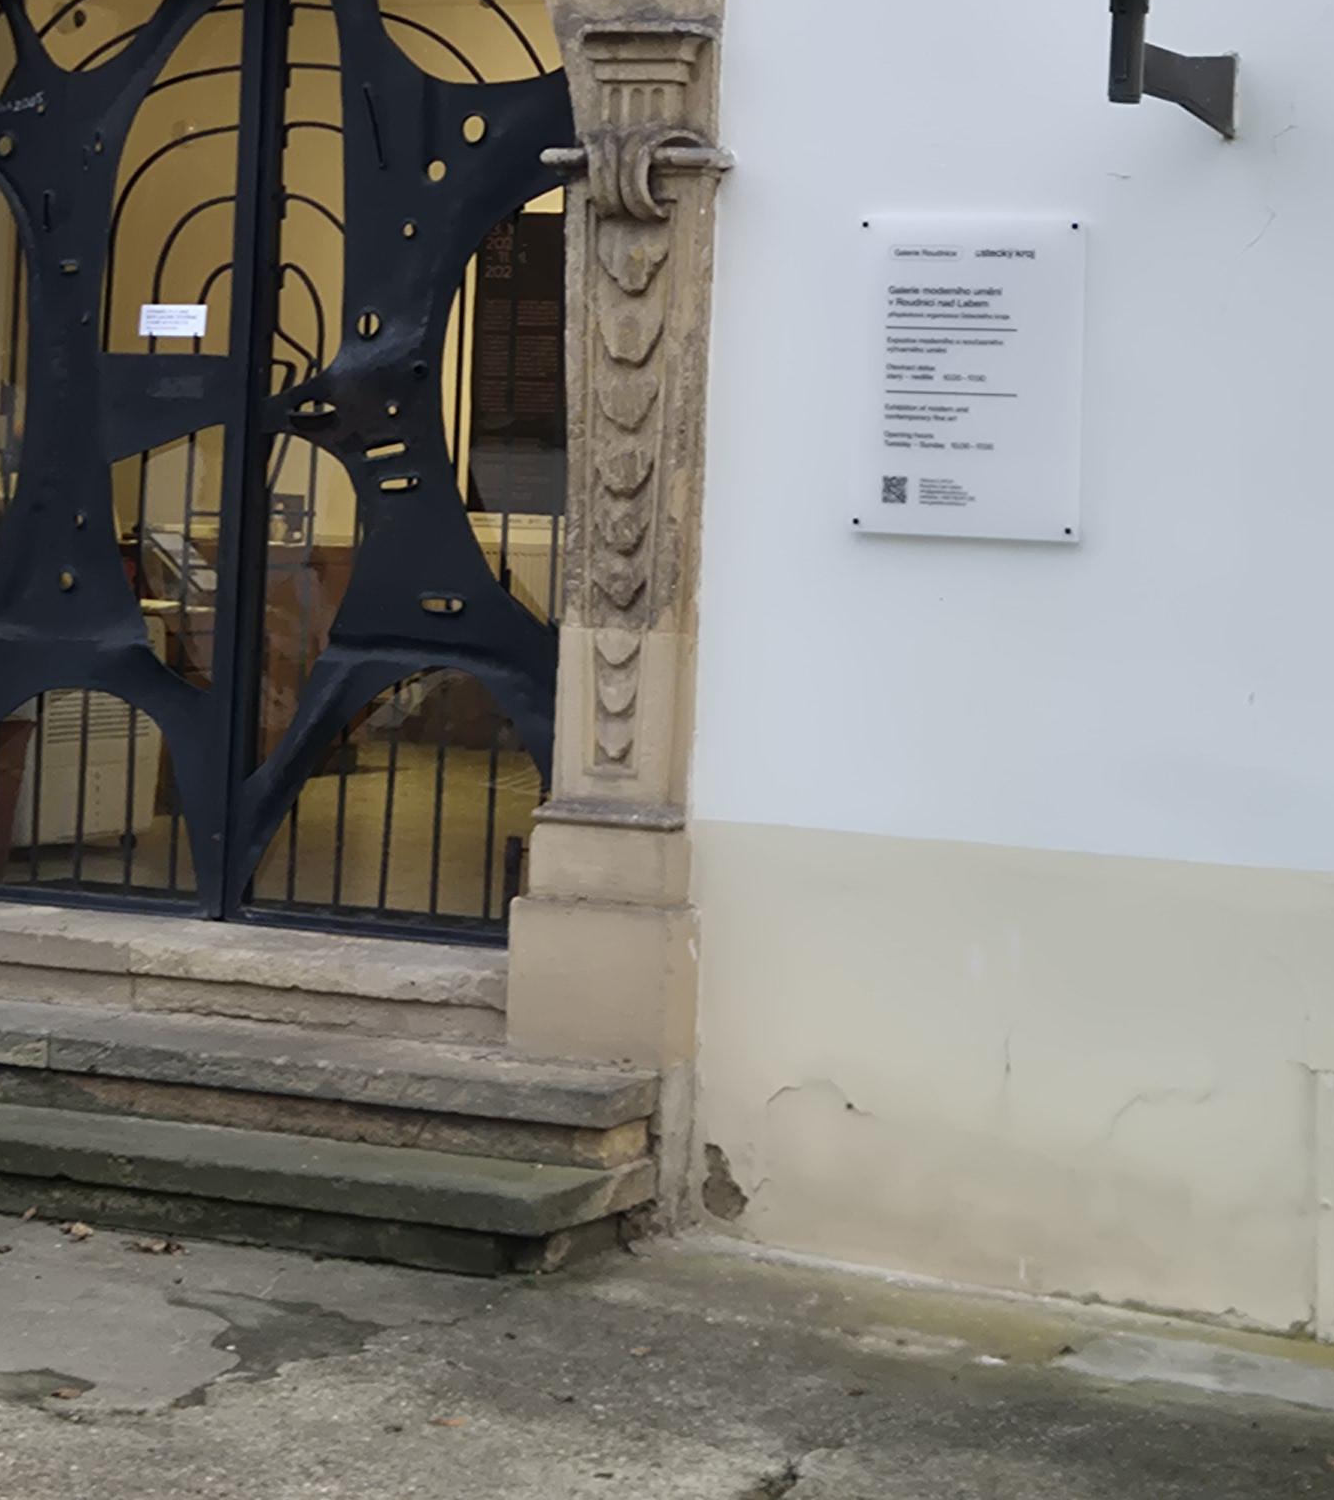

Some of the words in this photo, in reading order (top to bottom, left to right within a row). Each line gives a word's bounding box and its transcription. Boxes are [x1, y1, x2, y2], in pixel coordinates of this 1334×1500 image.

[894, 248, 920, 257] Galerie
[922, 248, 957, 257] Roudnice
[888, 286, 919, 295] Galerie
[922, 286, 972, 296] moderního
[973, 286, 1003, 297] umění
[896, 297, 936, 307] Roudnici
[937, 298, 955, 308] nad
[957, 299, 989, 308] Labem
[918, 337, 954, 345] moderního
[928, 405, 954, 413] modern
[955, 406, 969, 414] and
[884, 414, 931, 422] contemporary
[884, 431, 912, 440] Opening
[884, 440, 912, 449] Tuesday
[919, 441, 945, 450] Sunday
